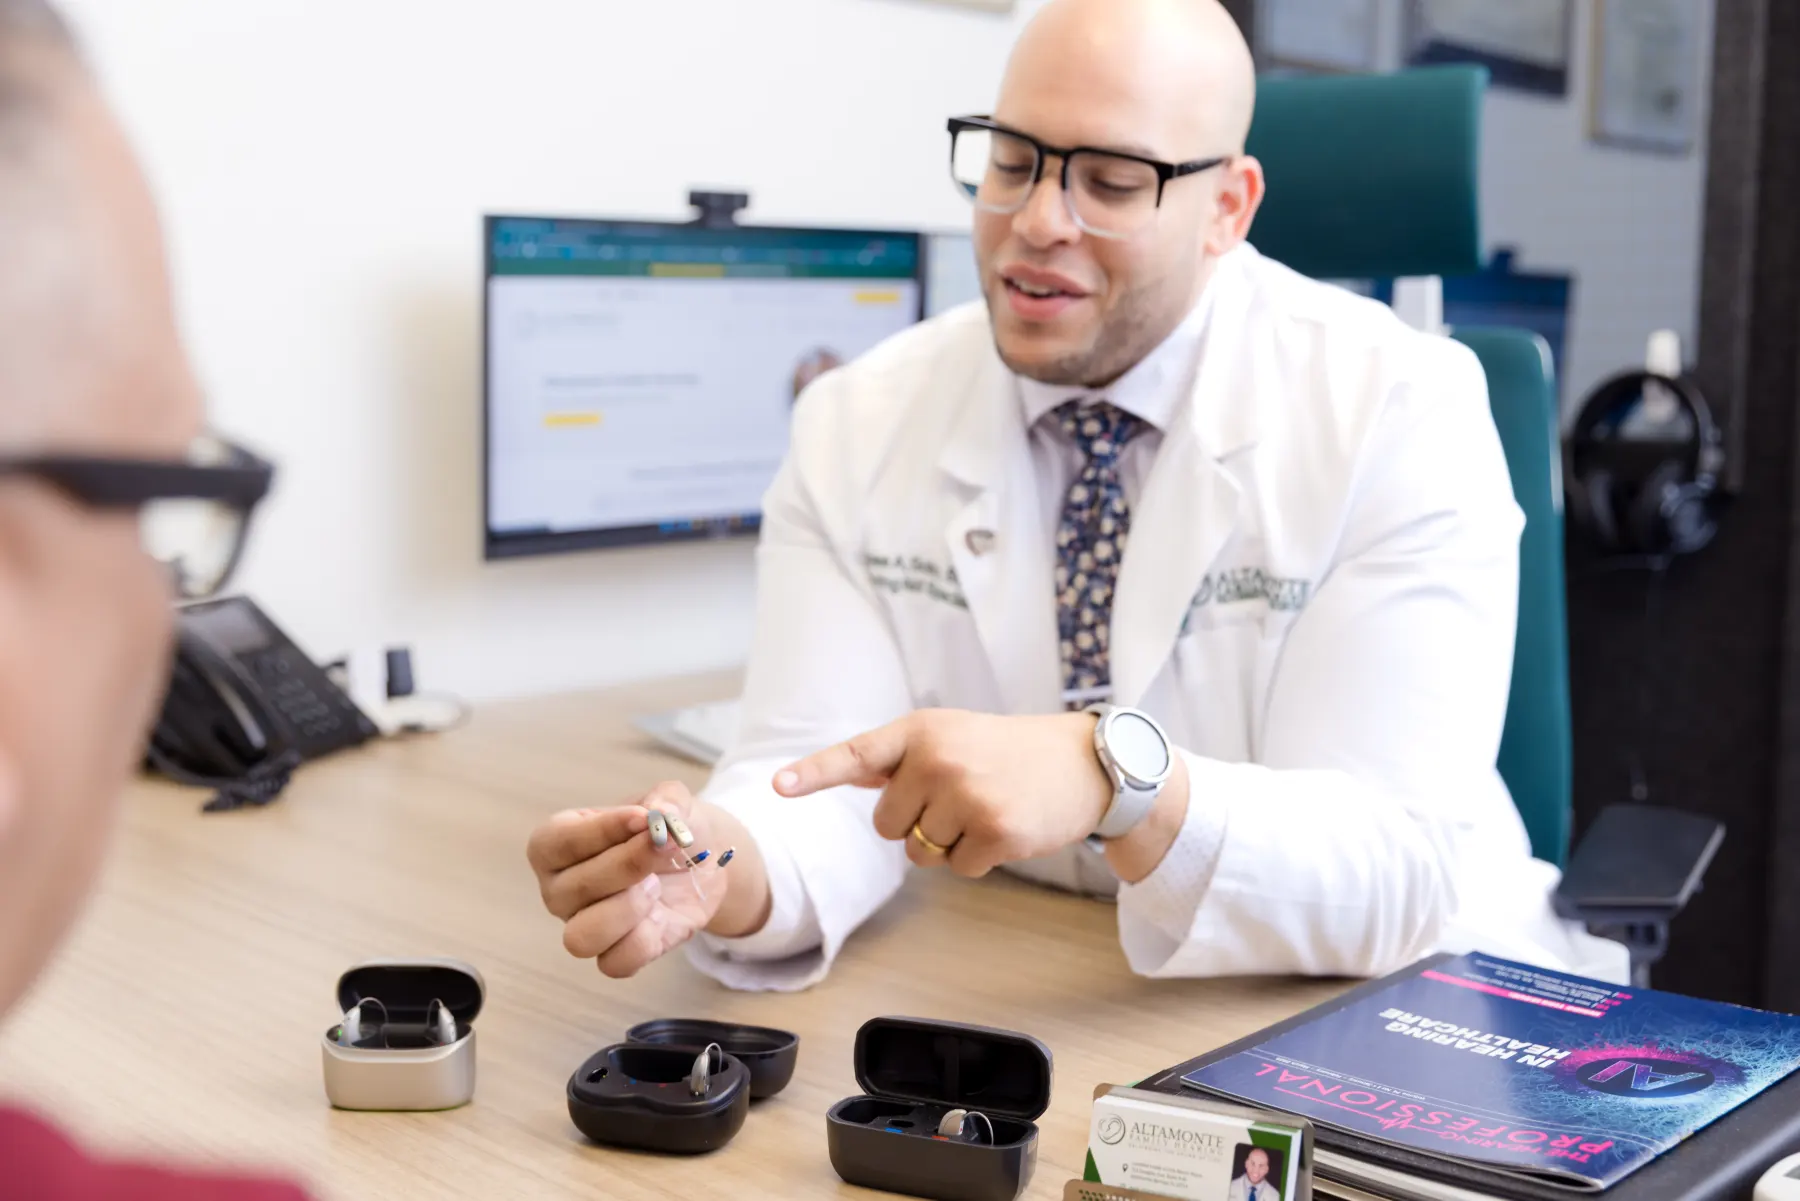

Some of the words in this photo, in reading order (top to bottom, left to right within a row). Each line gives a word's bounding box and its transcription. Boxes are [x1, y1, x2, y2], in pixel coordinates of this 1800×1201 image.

[1378, 1008, 1572, 1060] HEALTHCARE
[1384, 1021, 1511, 1061] HEARING
[1516, 1055, 1557, 1068] IN
[1588, 1060, 1705, 1091] AI
[1255, 1063, 1614, 1154] PROFESSIONAL
[1130, 1133, 1168, 1146] FAMILY
[1174, 1141, 1223, 1156] HEARING
[1131, 1122, 1225, 1148] ALTAMONTE
[1437, 1131, 1542, 1154] HEARING
[1545, 1149, 1591, 1163] THE
